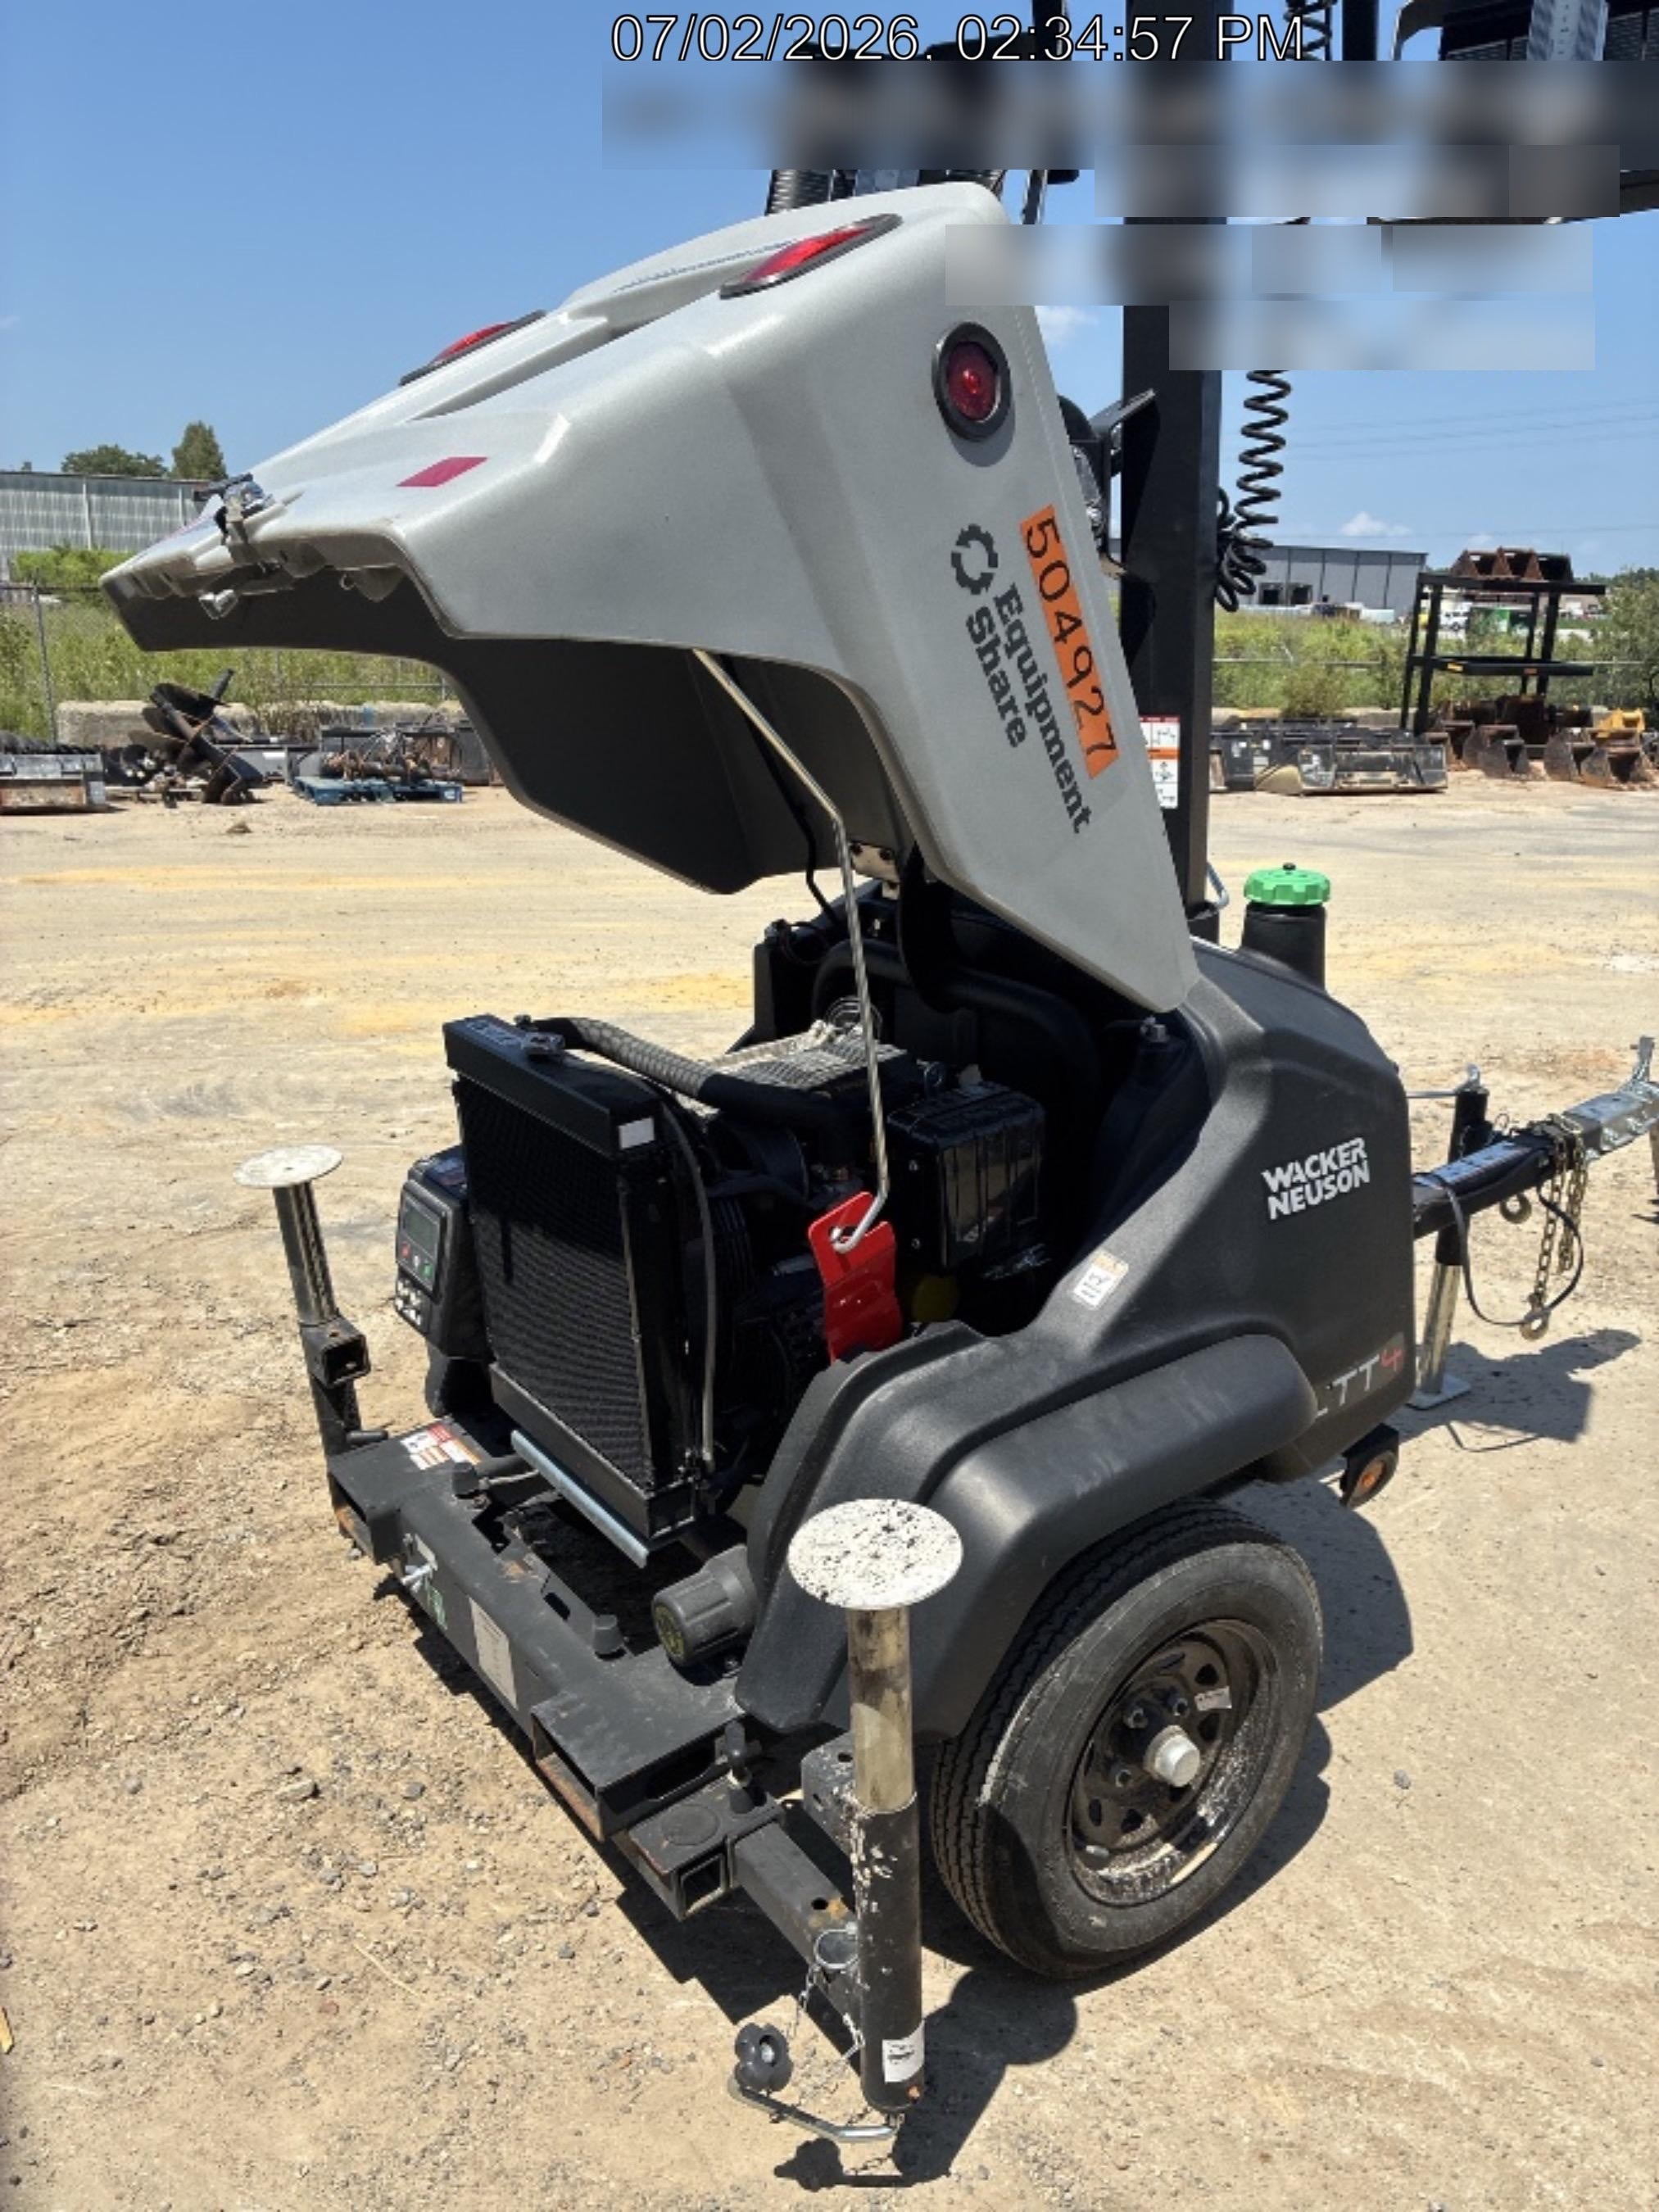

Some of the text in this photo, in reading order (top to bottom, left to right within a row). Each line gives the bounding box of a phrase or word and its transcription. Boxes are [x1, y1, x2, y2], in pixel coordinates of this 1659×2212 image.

[966, 605, 1026, 747] Share
[993, 582, 1091, 834] Equipment
[1027, 518, 1117, 756] 504927
[1262, 1137, 1367, 1192] WACKER
[1267, 1160, 1370, 1220] NEUSON
